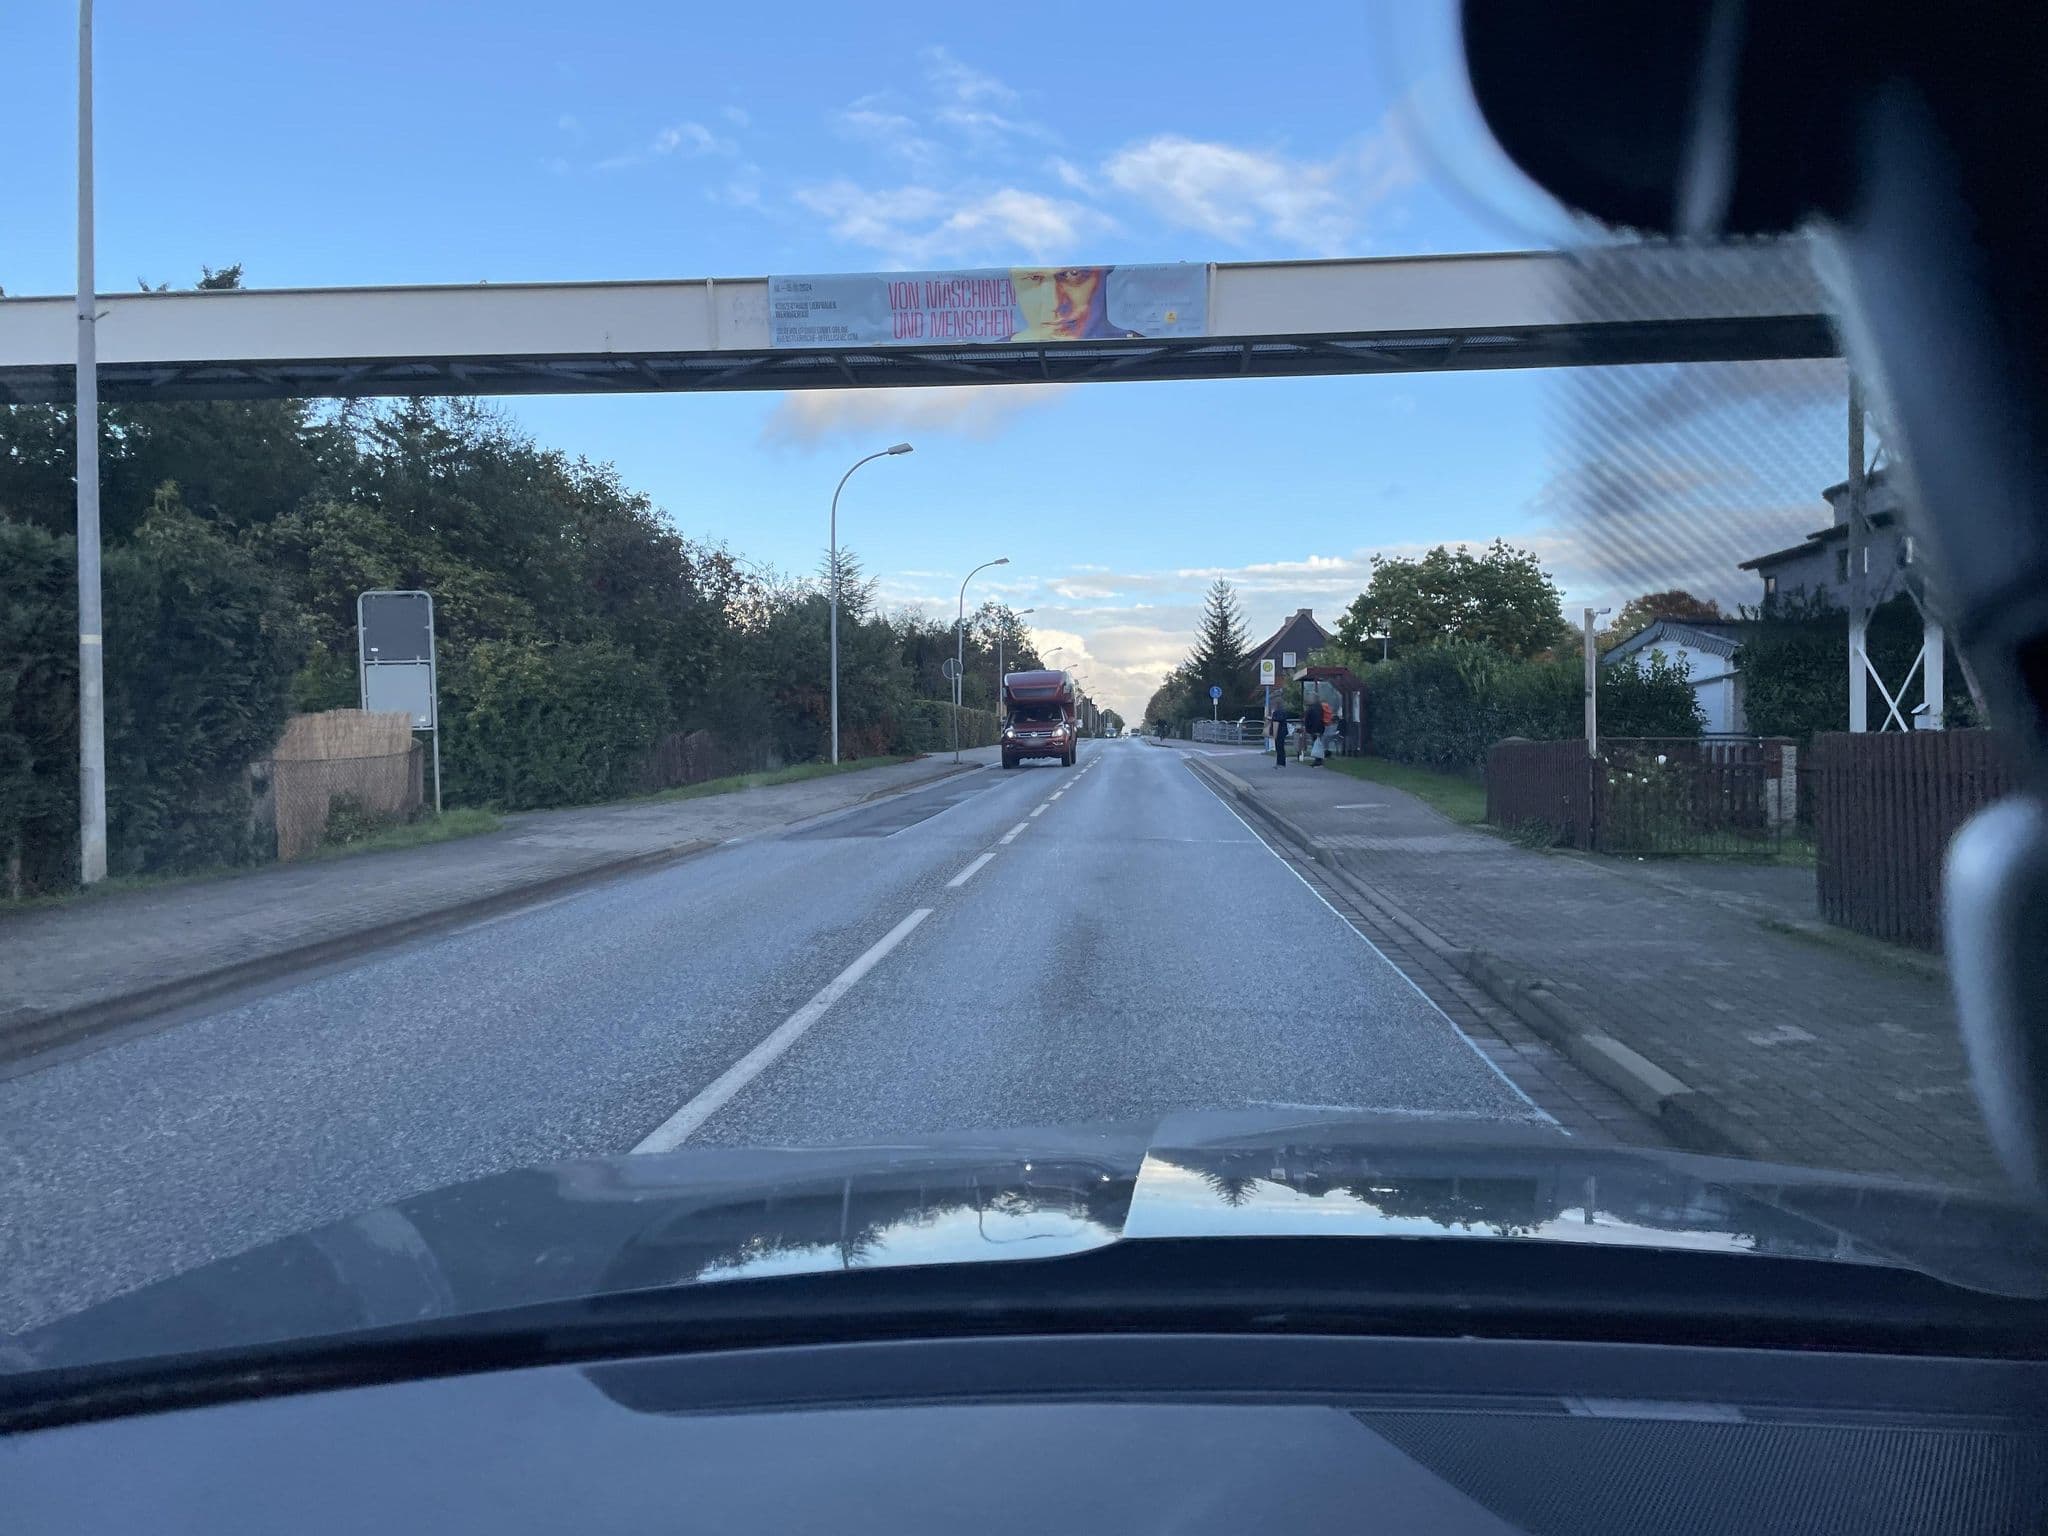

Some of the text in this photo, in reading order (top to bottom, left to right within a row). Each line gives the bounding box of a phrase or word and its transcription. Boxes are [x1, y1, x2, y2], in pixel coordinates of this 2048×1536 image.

[888, 278, 1016, 309] VON MASCHINEN
[894, 312, 923, 339] UND
